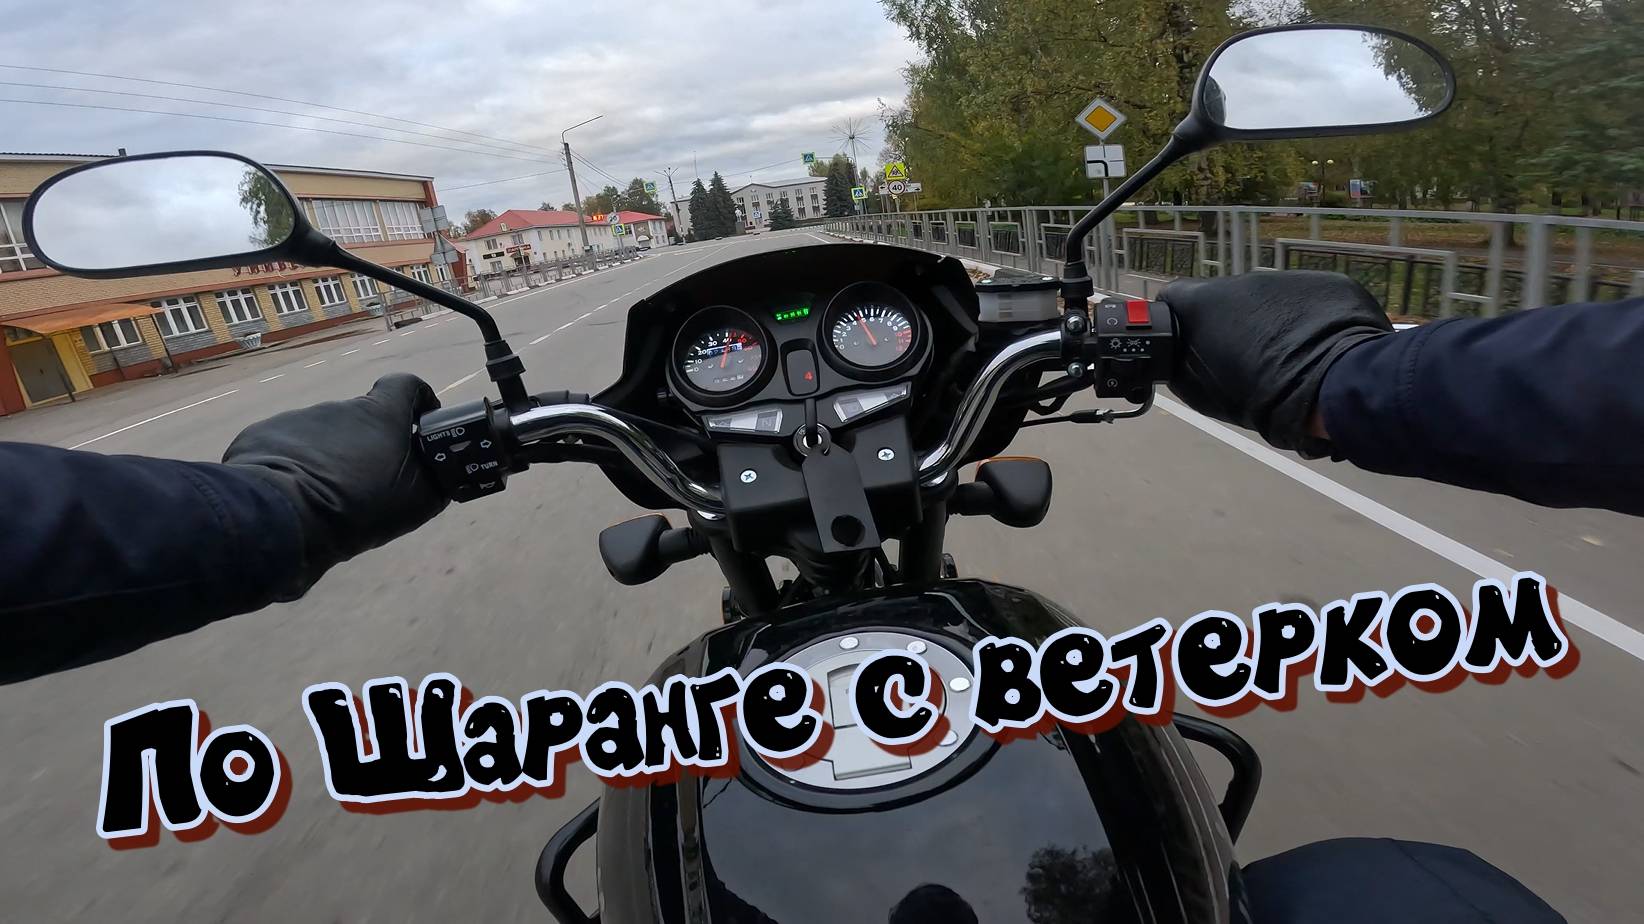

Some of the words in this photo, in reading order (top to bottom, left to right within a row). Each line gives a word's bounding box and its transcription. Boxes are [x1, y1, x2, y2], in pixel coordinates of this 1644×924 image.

[804, 371, 813, 381] 4
[426, 430, 451, 442] LIGHTS
[480, 461, 498, 470] TURN
